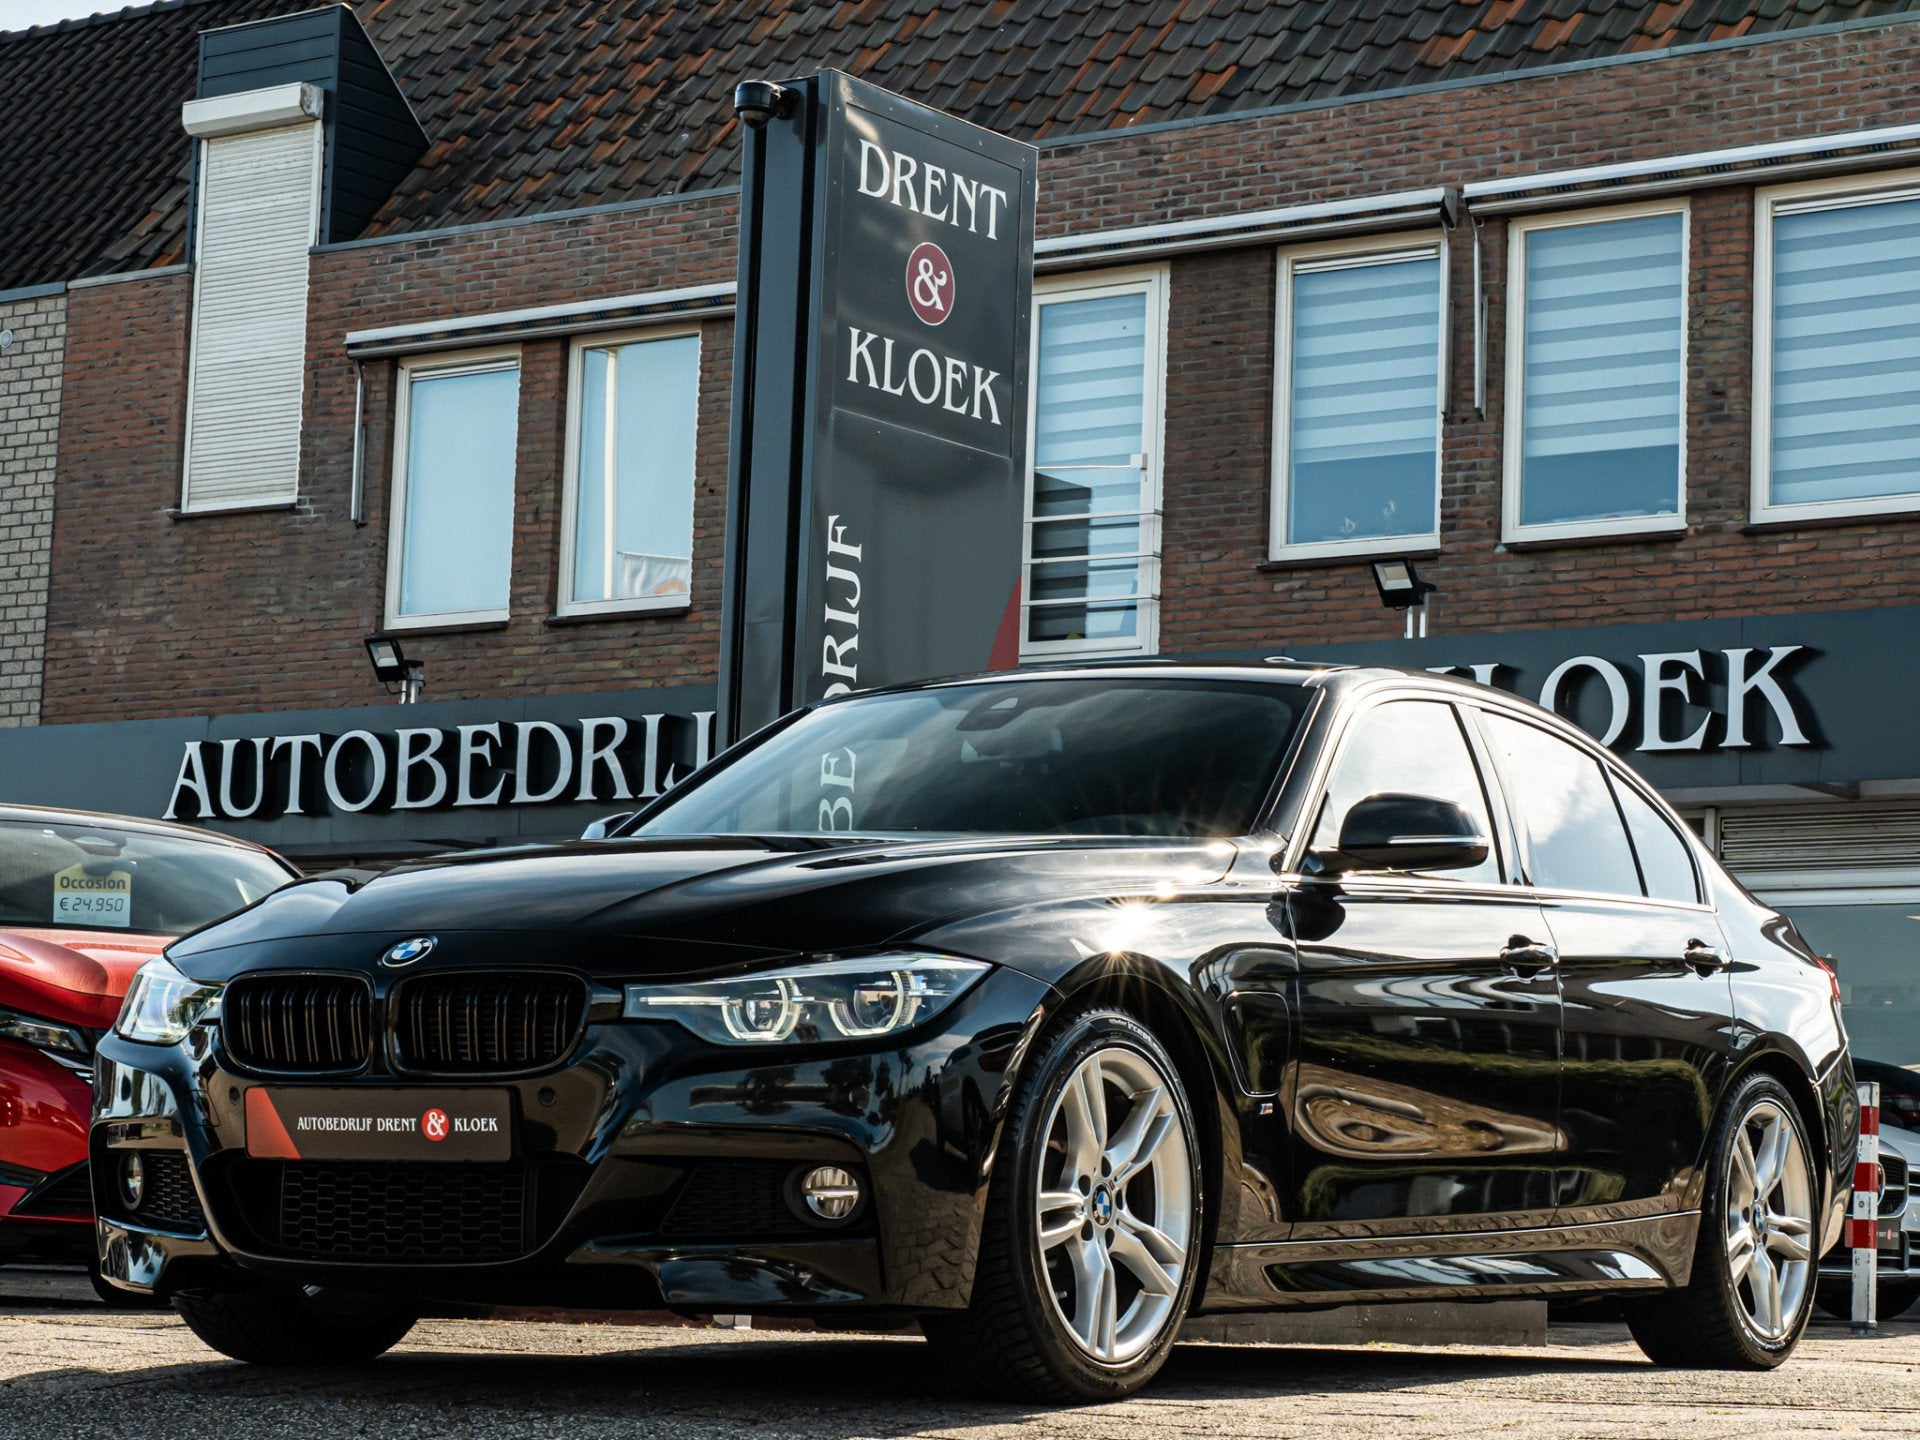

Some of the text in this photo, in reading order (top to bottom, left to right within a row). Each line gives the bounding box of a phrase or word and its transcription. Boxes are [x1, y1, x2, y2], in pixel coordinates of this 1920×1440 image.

[857, 139, 1007, 240] DRENT
[913, 257, 948, 312] &
[846, 325, 1003, 426] KLOEK
[1425, 644, 1811, 752] OEK
[60, 876, 126, 889] Occasion
[60, 897, 124, 911] € 24.950
[297, 1111, 498, 1136] AUTOBEDRIJF DRENT & KLOEK
